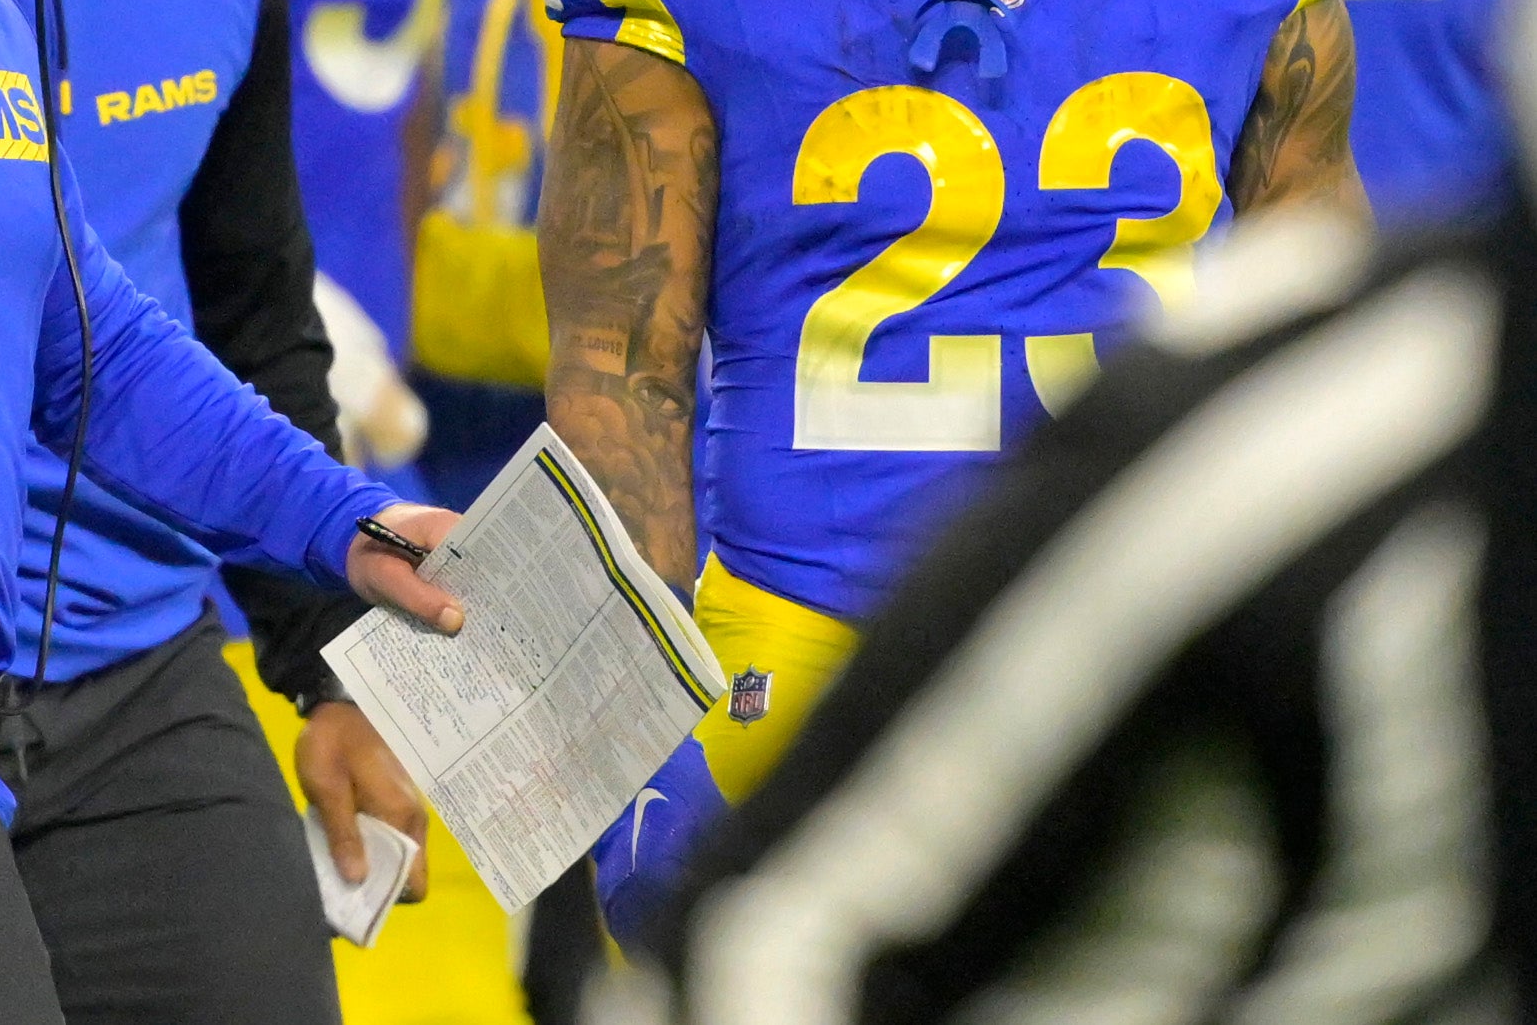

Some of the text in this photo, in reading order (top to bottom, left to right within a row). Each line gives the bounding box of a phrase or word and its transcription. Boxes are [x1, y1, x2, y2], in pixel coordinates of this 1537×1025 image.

[96, 68, 218, 126] RAMS
[792, 71, 1224, 452] 23
[732, 690, 766, 714] NFL
